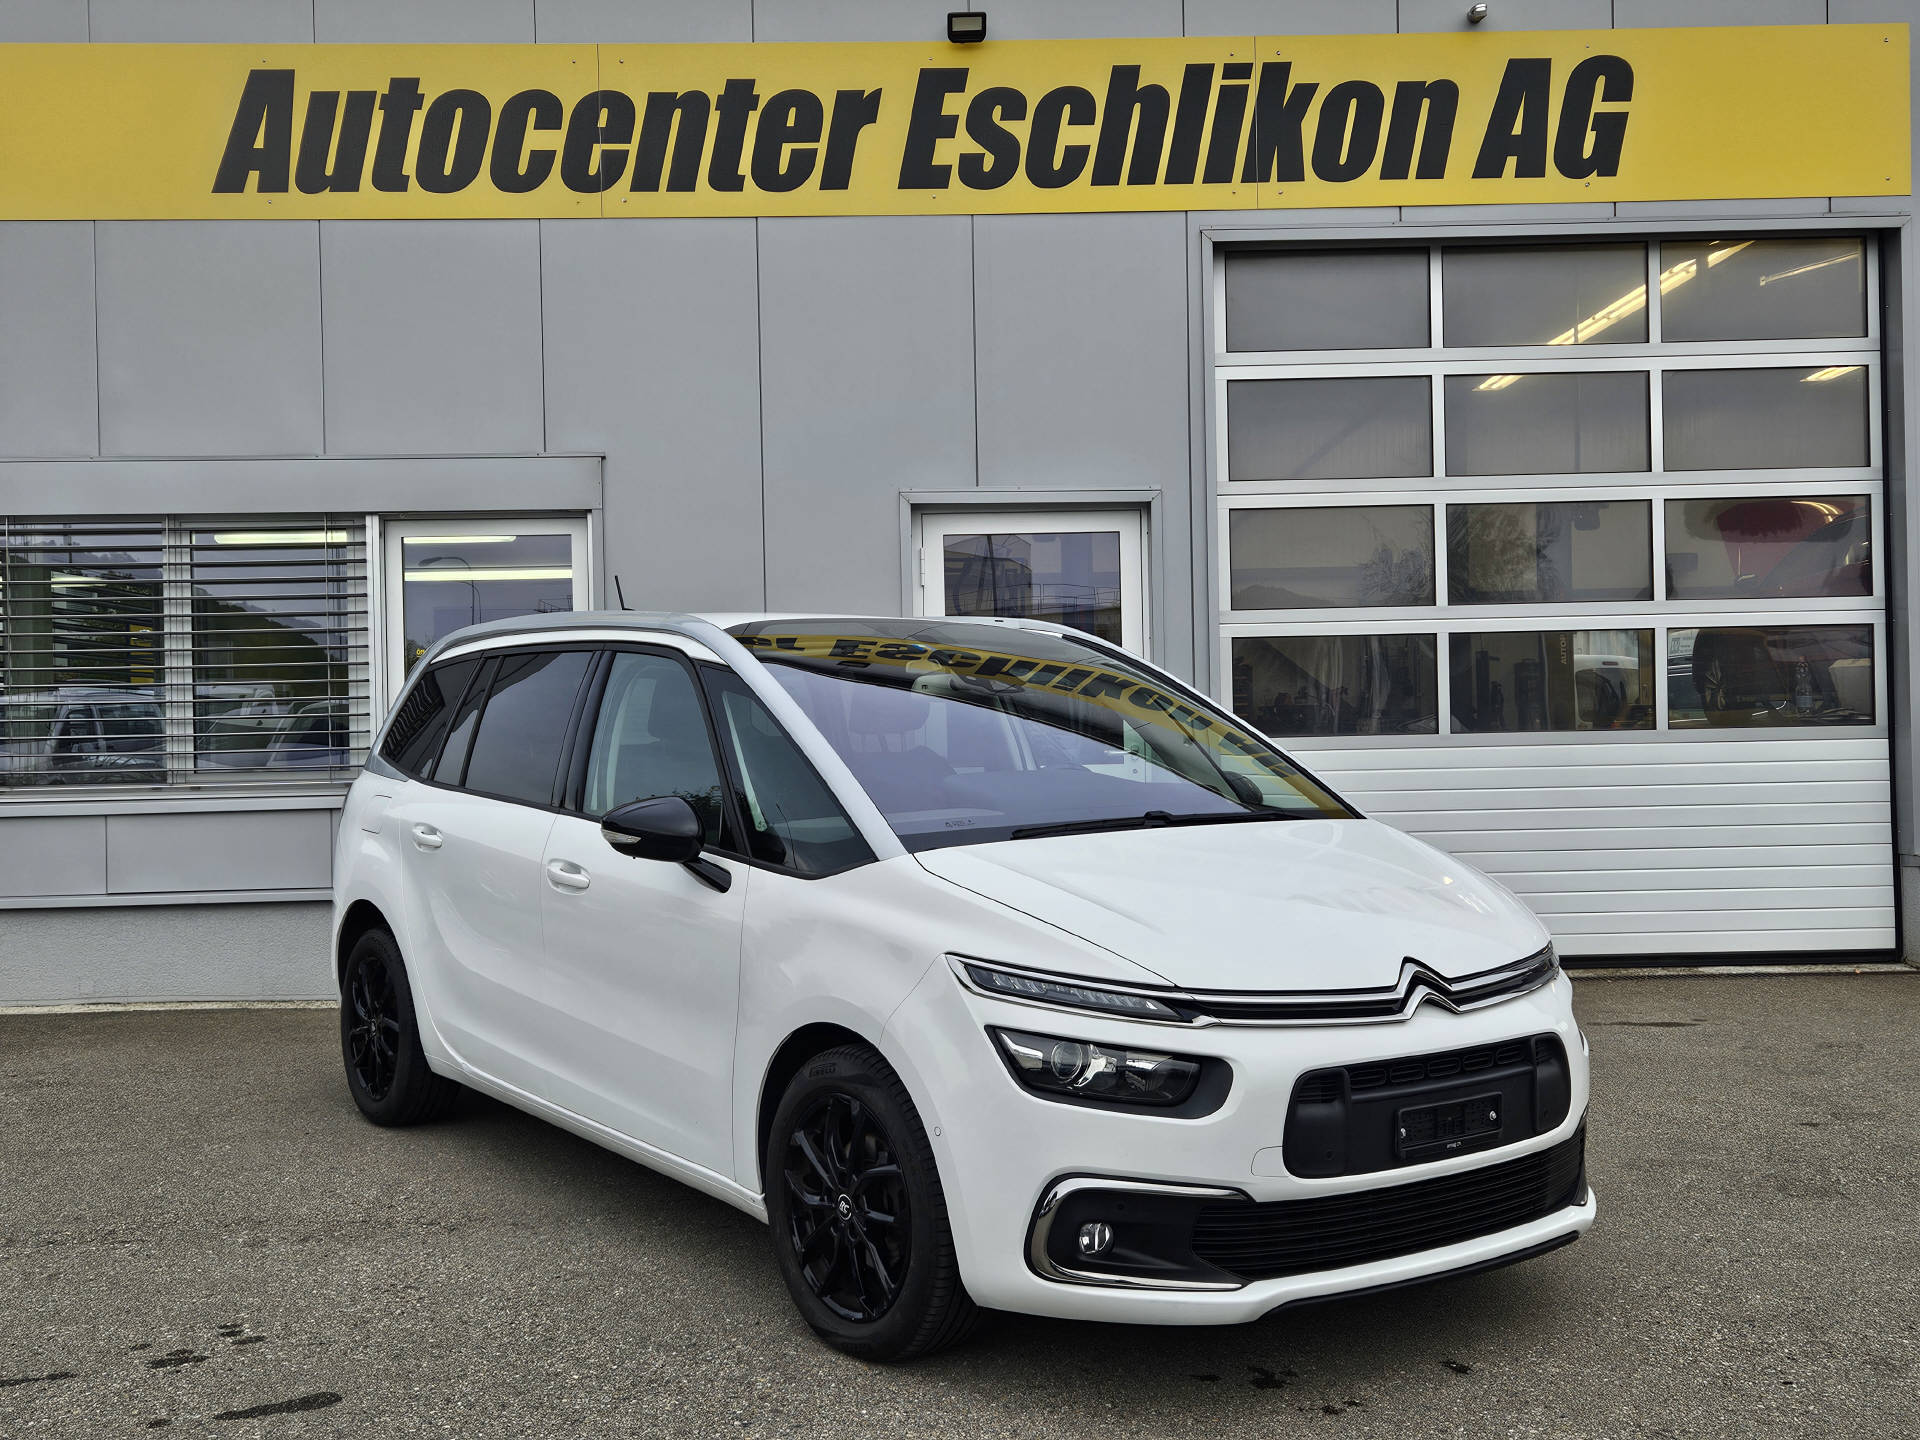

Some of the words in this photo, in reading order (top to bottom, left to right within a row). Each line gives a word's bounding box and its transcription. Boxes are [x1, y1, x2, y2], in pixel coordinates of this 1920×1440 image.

[212, 67, 883, 195] Autocenter
[898, 61, 1460, 191] Eschlikon
[1471, 54, 1635, 180] AG
